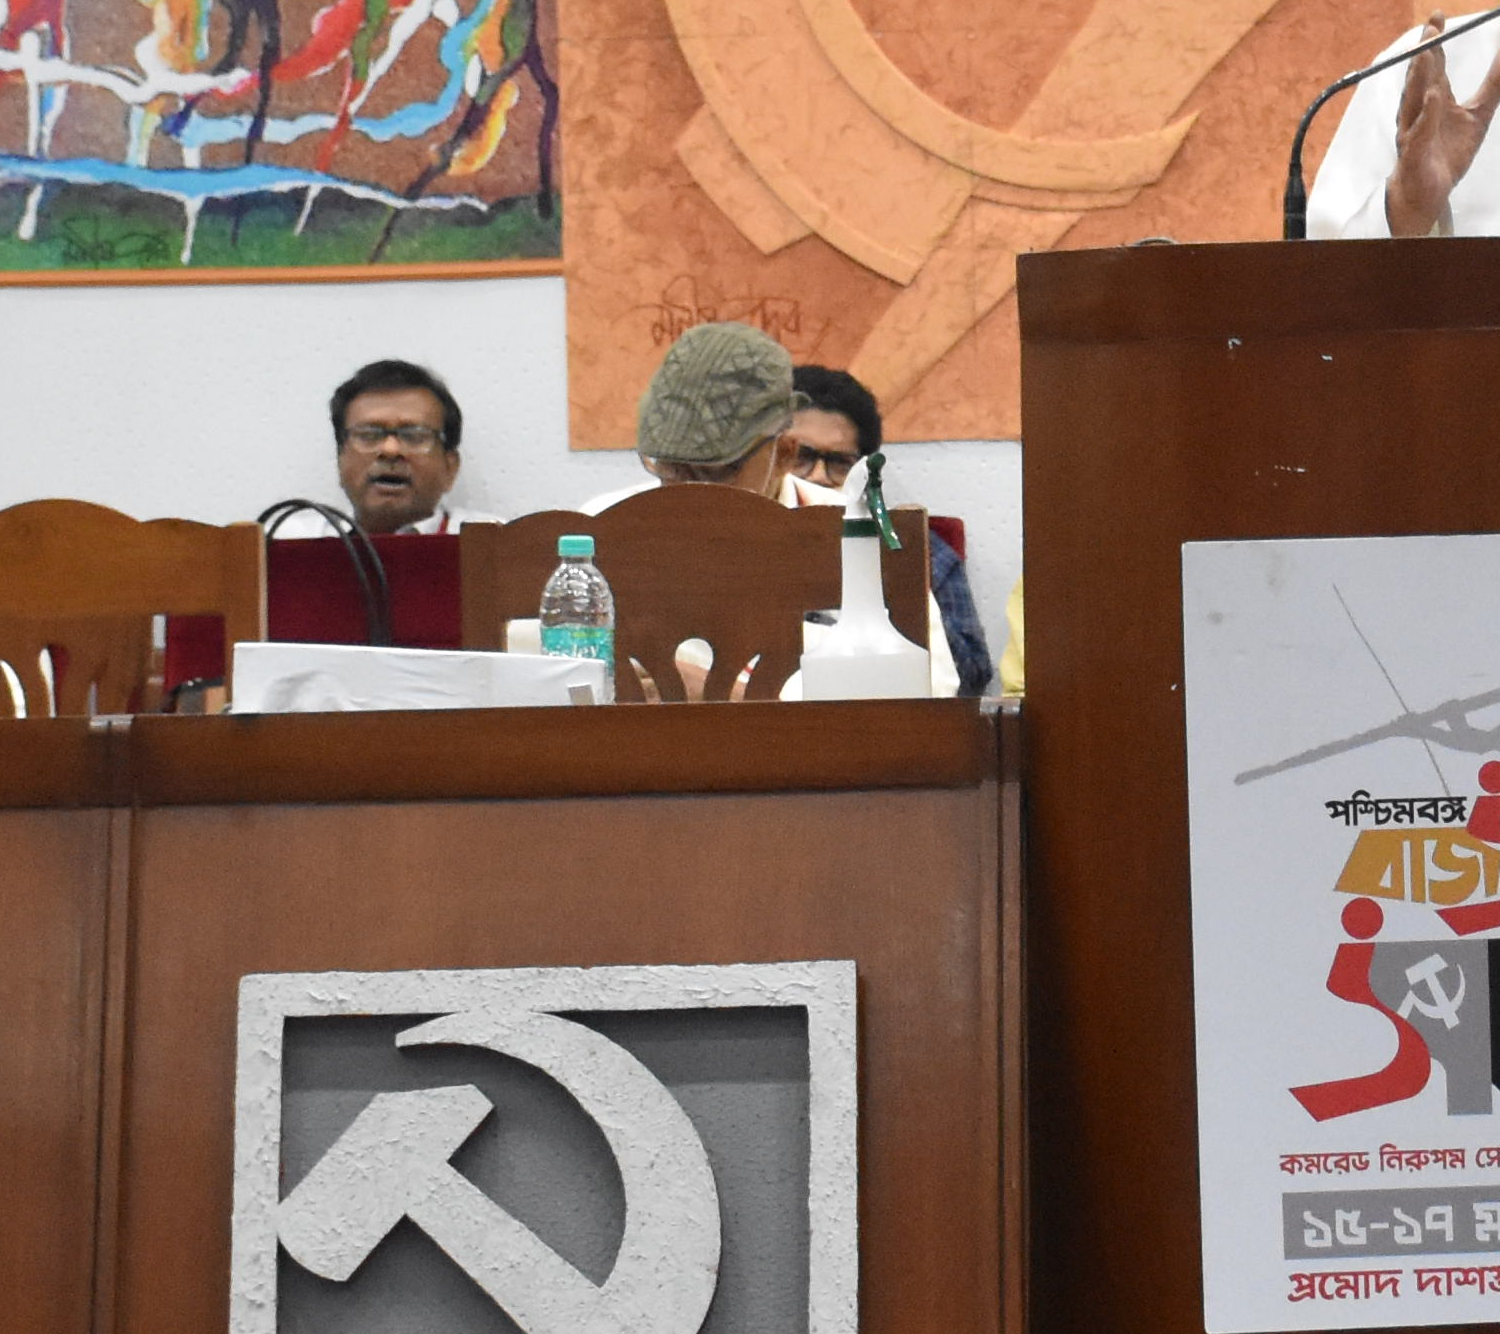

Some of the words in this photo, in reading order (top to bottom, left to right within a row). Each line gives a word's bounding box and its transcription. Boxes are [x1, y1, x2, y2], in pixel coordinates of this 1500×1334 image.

[1325, 789, 1468, 827] পশ্চিমবঙ্গ
[1279, 1151, 1370, 1175] কমরেড
[1379, 1143, 1465, 1173] নিরুপম
[1303, 1204, 1454, 1249] ১৫-১৭
[1287, 1269, 1403, 1303] প্রমোদ
